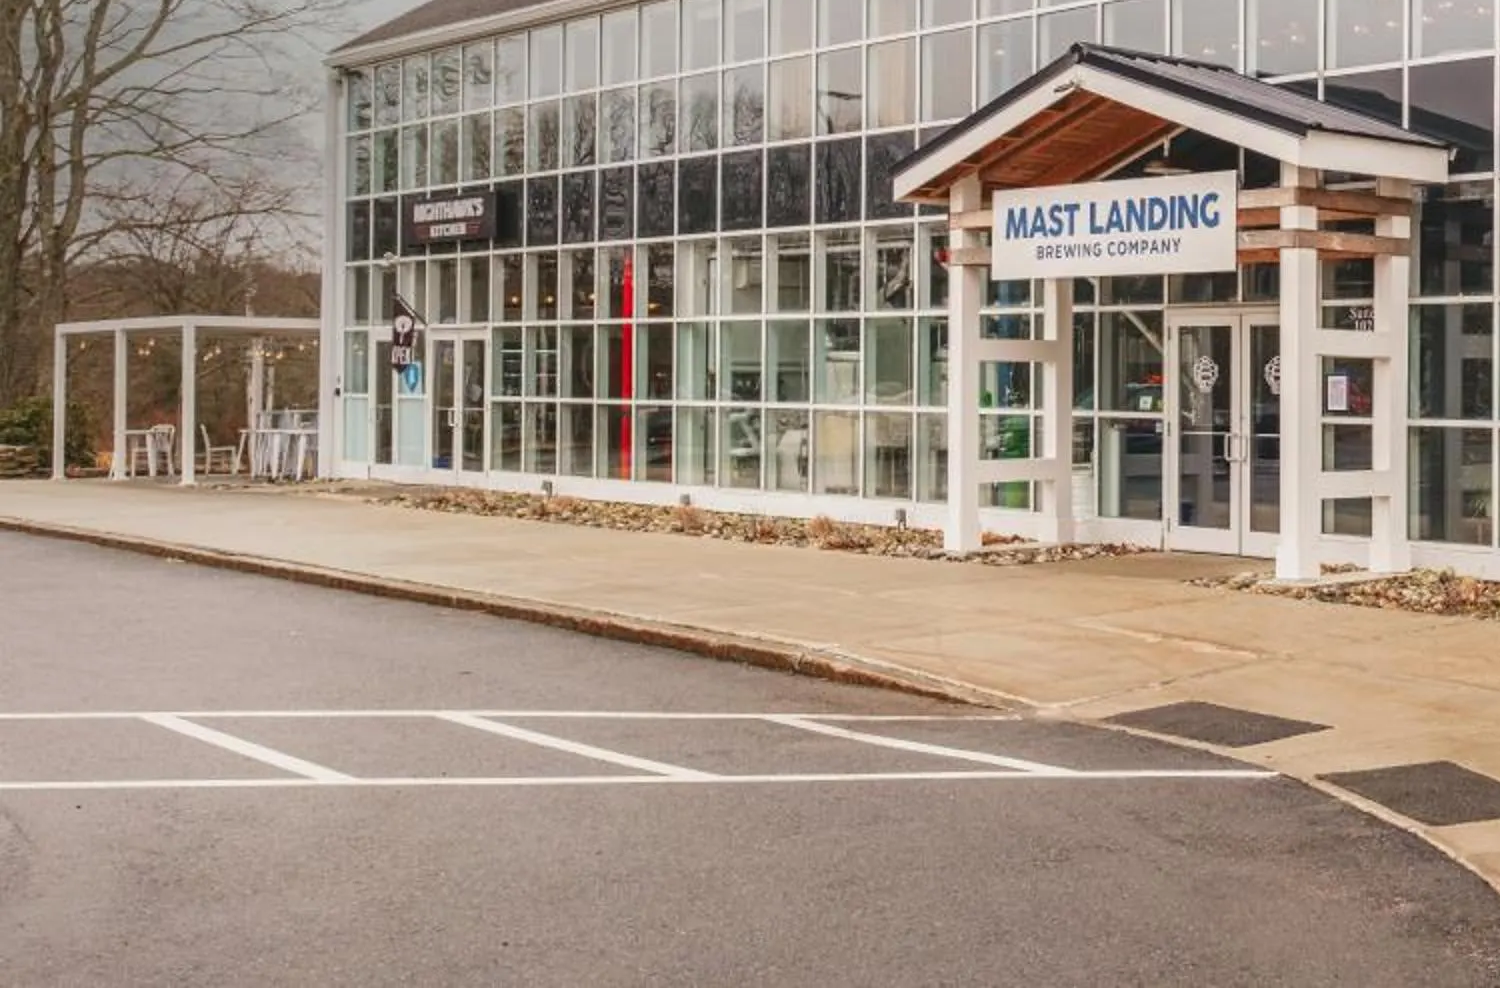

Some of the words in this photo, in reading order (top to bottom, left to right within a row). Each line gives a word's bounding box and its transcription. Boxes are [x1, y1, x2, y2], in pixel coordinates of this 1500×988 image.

[1005, 202, 1080, 240] MAST
[1089, 192, 1220, 235] LANDING
[1036, 241, 1102, 261] BREWING
[1107, 237, 1182, 257] COMPANY
